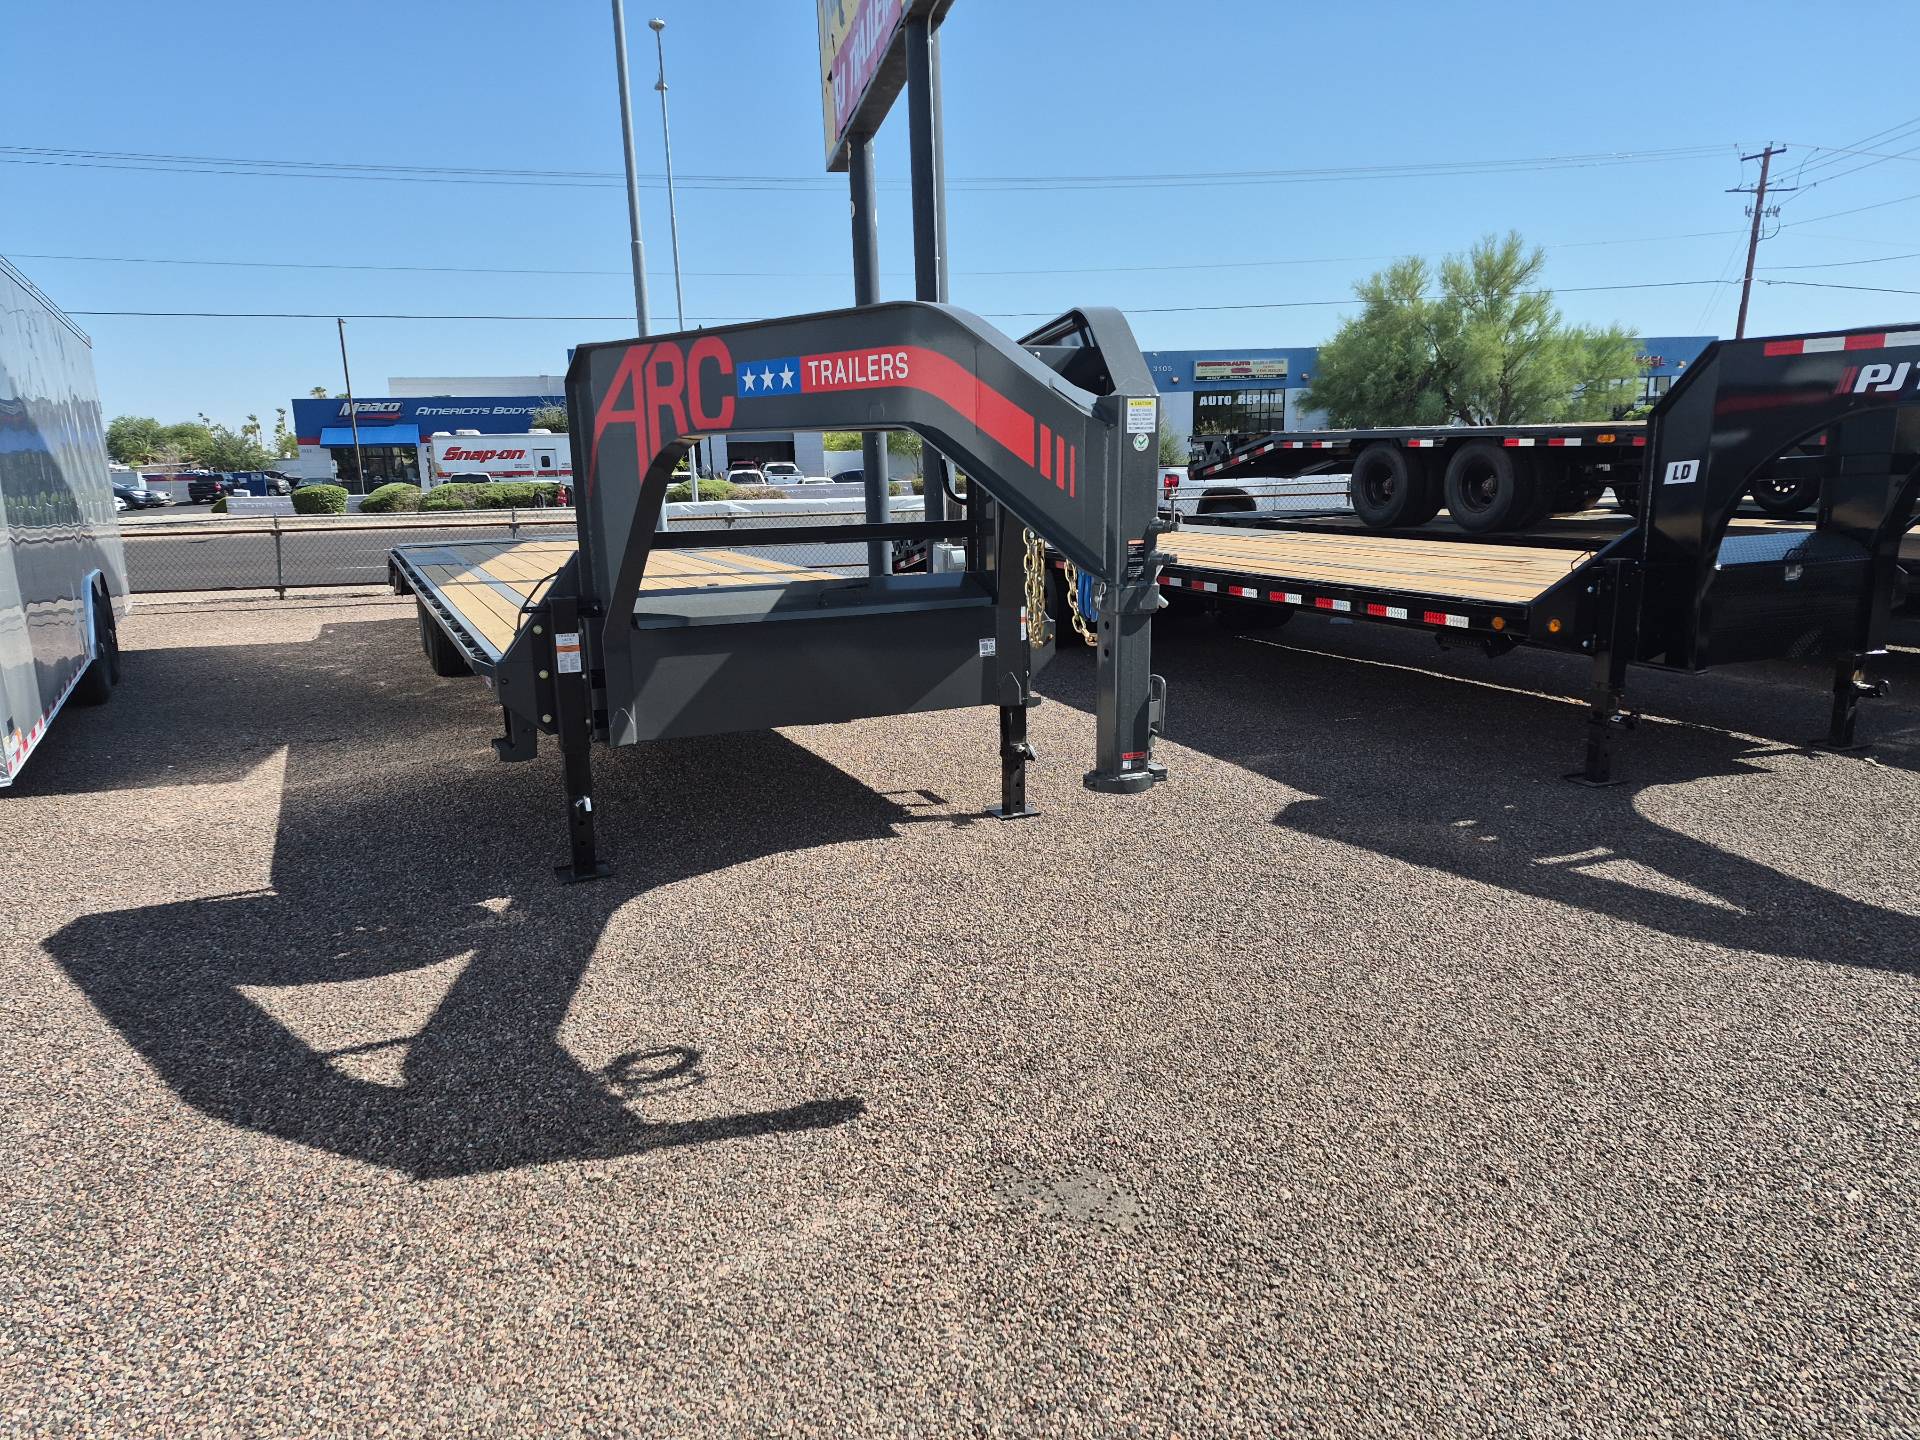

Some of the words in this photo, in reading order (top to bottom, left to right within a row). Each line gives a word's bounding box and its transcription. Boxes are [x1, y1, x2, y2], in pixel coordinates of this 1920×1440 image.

[1853, 362, 1911, 393] PJ
[1200, 395, 1231, 406] AUTO
[1237, 393, 1283, 405] REPAIR
[587, 336, 735, 499] ARC
[808, 352, 909, 386] TRAILERS
[443, 447, 526, 463] Snap-on
[1672, 463, 1692, 481] LD
